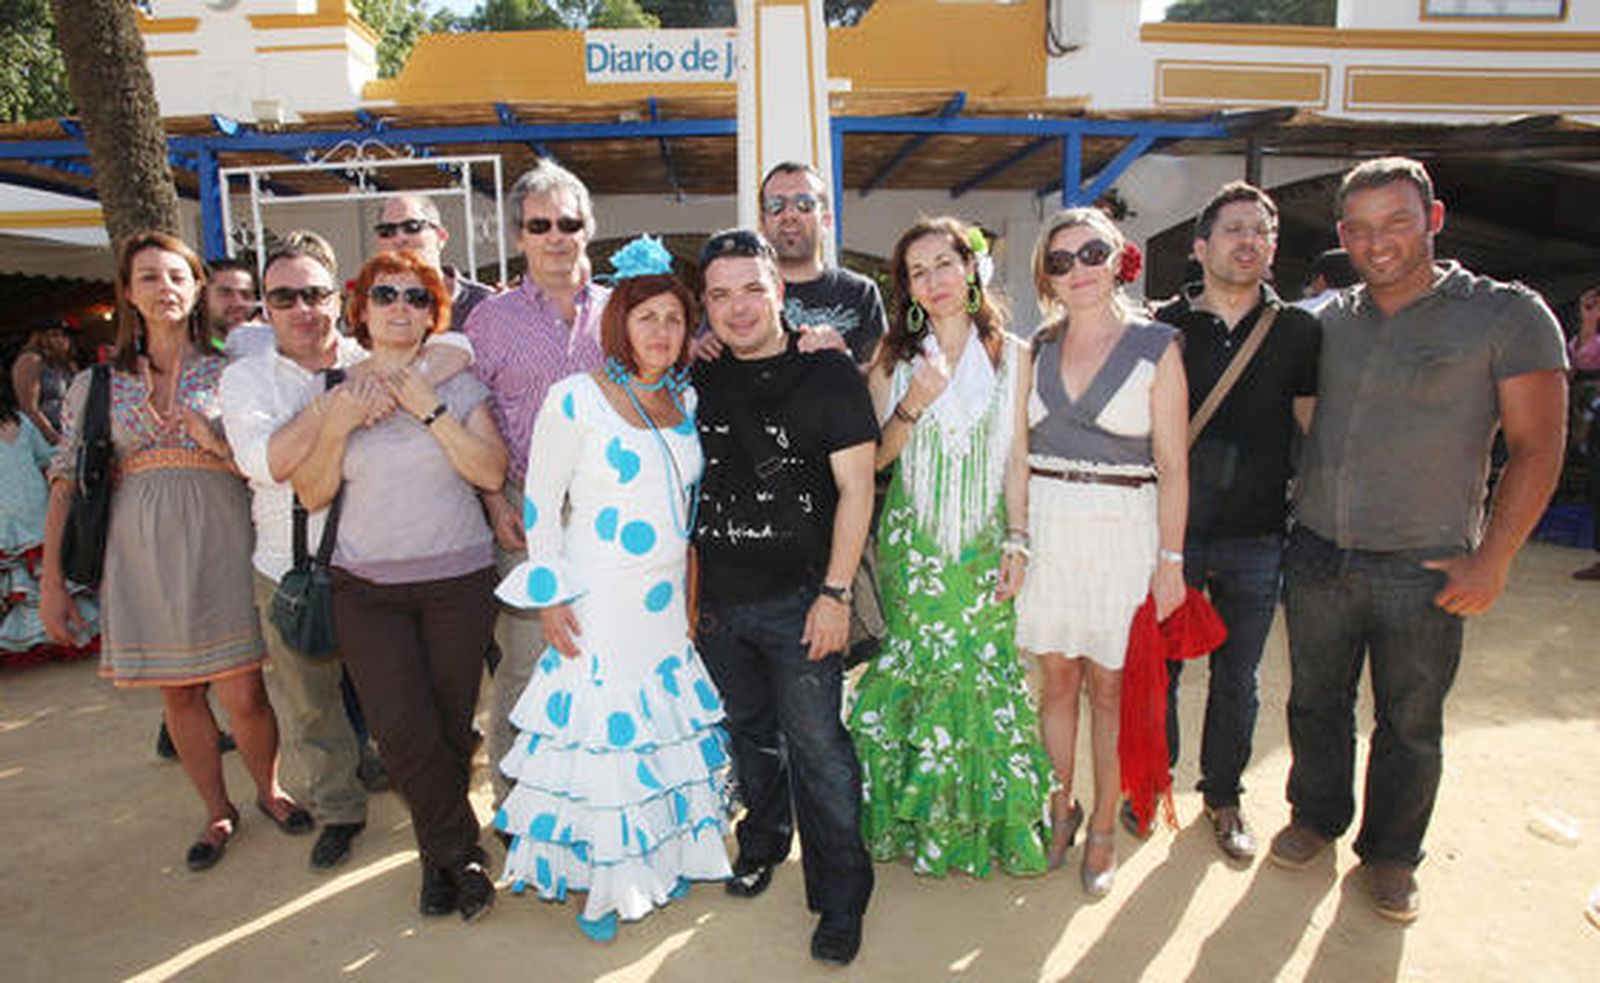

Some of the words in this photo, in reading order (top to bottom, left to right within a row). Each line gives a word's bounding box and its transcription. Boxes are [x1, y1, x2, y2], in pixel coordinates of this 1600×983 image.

[586, 42, 674, 73] Diario
[680, 38, 718, 72] de
[724, 40, 738, 79] J
